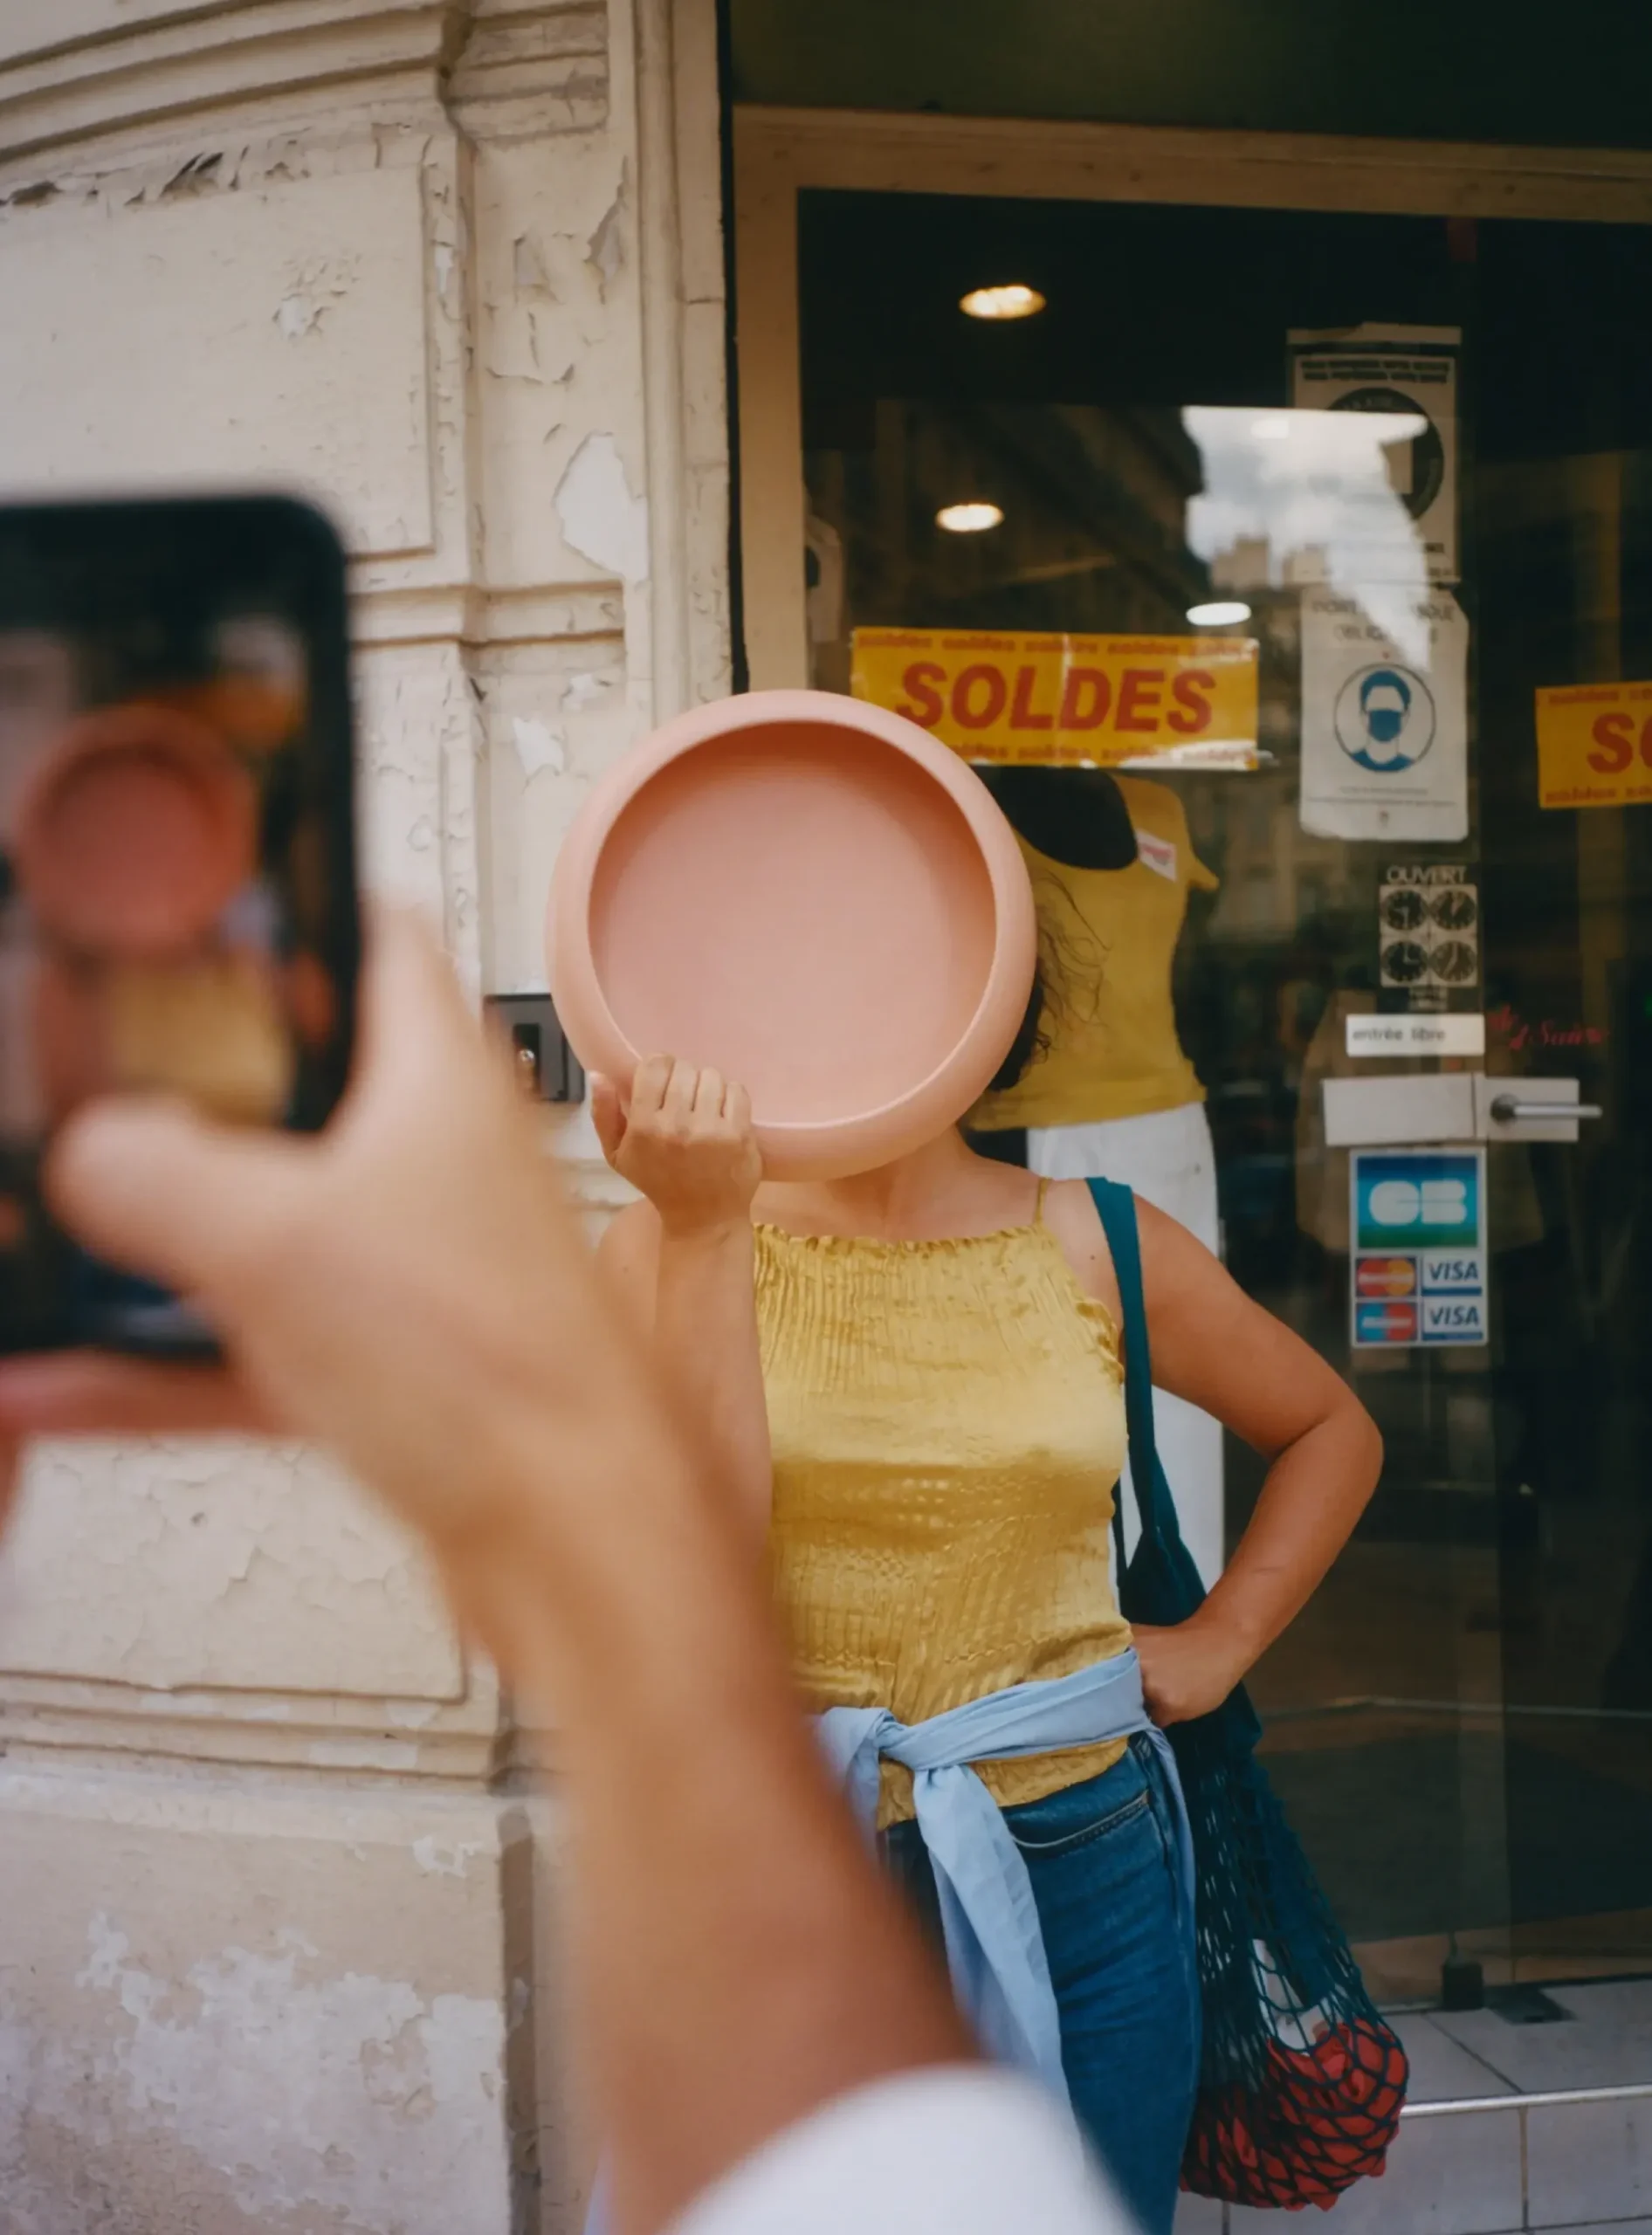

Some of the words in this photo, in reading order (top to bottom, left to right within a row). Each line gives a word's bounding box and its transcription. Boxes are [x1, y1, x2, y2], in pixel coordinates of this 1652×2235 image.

[895, 661, 1217, 734] SOLDES
[1587, 712, 1652, 774] S
[1428, 1261, 1479, 1282] VISA
[1430, 1305, 1480, 1326] VISA
